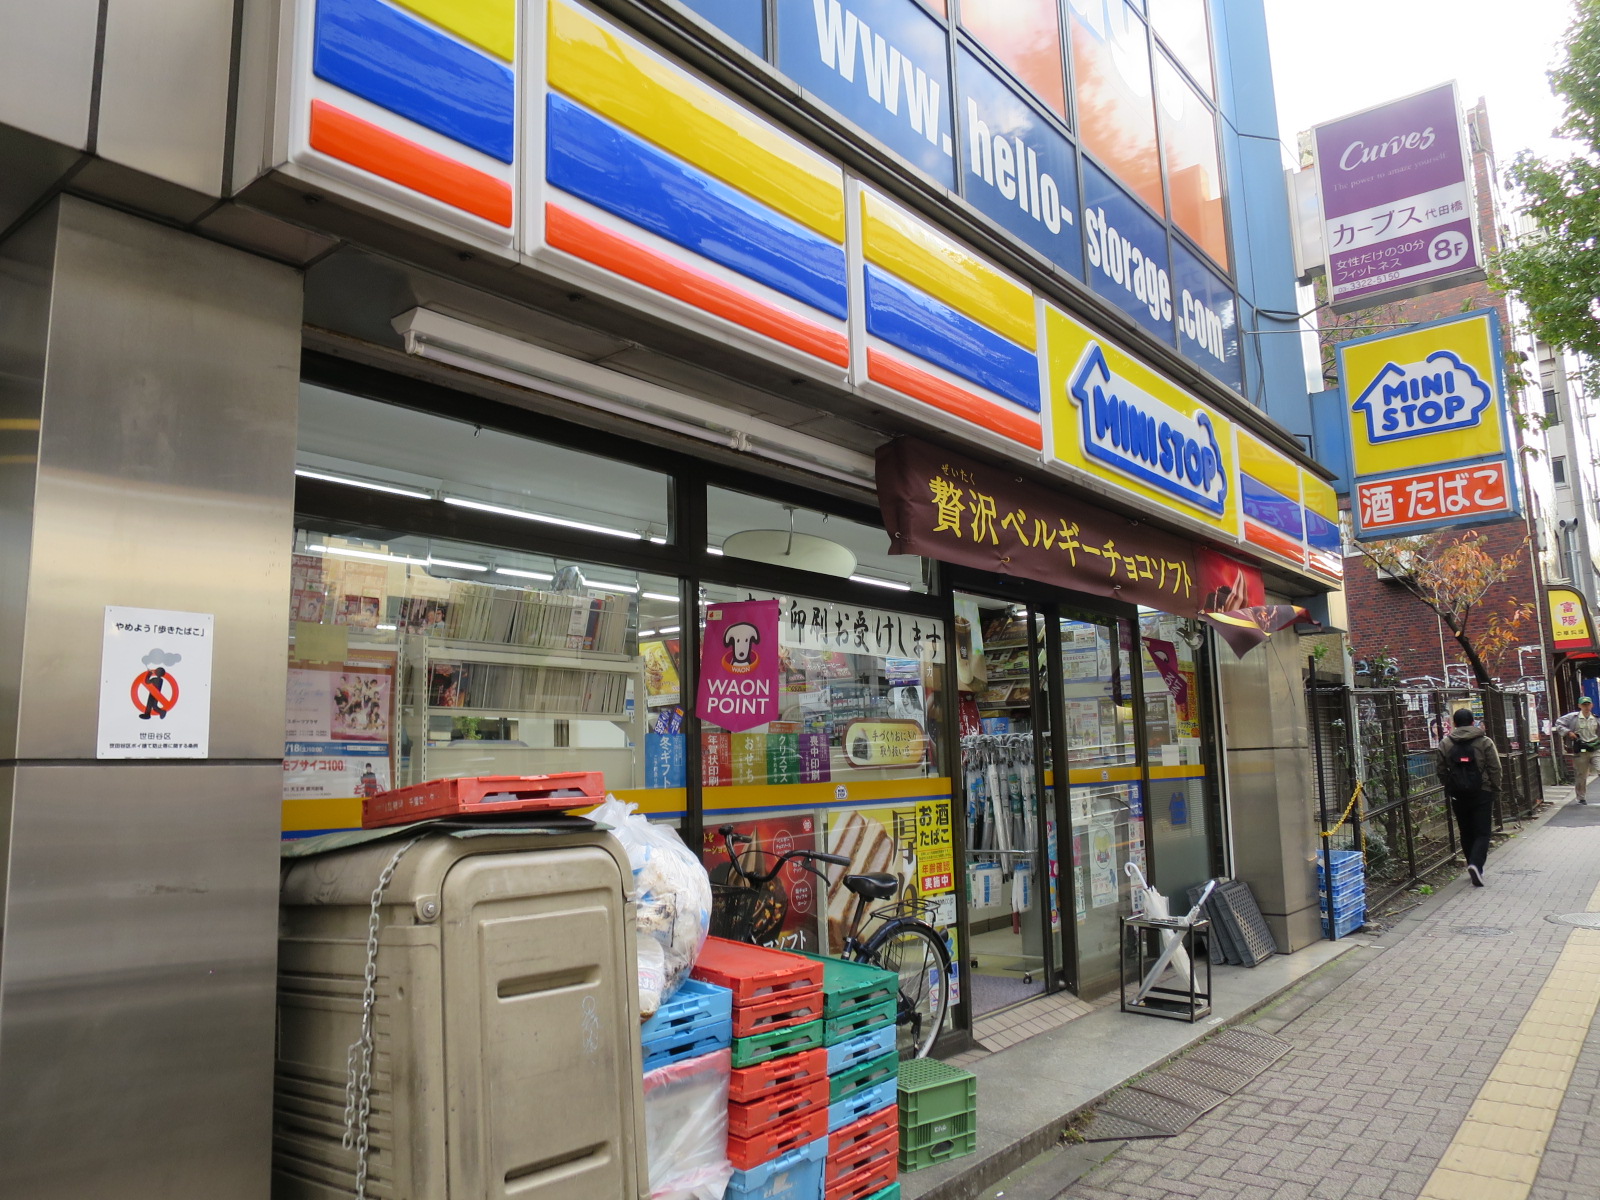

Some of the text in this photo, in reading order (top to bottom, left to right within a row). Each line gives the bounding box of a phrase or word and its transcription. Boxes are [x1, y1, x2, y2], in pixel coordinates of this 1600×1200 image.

[811, 0, 953, 157] www.
[967, 97, 1073, 236] hello-
[1086, 207, 1172, 322] storage
[1339, 127, 1437, 171] Curves
[1333, 200, 1463, 248] カーブス 代田橋
[1336, 239, 1425, 269] 女性だけの30分
[1434, 239, 1464, 262] 8F
[1338, 258, 1403, 282] フィットネス
[1382, 370, 1456, 406] MINI
[1382, 395, 1466, 432] STOP
[941, 463, 975, 485] ぜいたく
[1362, 470, 1504, 524] 酒・たばこ
[928, 475, 1193, 599] 贅沢ベルギーチョコソフト
[116, 622, 205, 637] やめよう「歩きたばこ」
[778, 600, 942, 660] 印刷お受けします
[707, 679, 770, 696] WAON
[707, 697, 770, 715] POINT
[140, 732, 171, 741] 世田谷区
[660, 736, 671, 789] 冬ギフト
[707, 735, 719, 787] 年賀状印刷
[744, 736, 754, 783] おせち
[779, 735, 788, 783] クリスマス
[810, 735, 820, 781] 喪中印刷
[919, 803, 949, 827] お酒
[920, 828, 950, 847] たばこ
[921, 861, 950, 875] 年齢確認
[924, 875, 949, 890] 実施中
